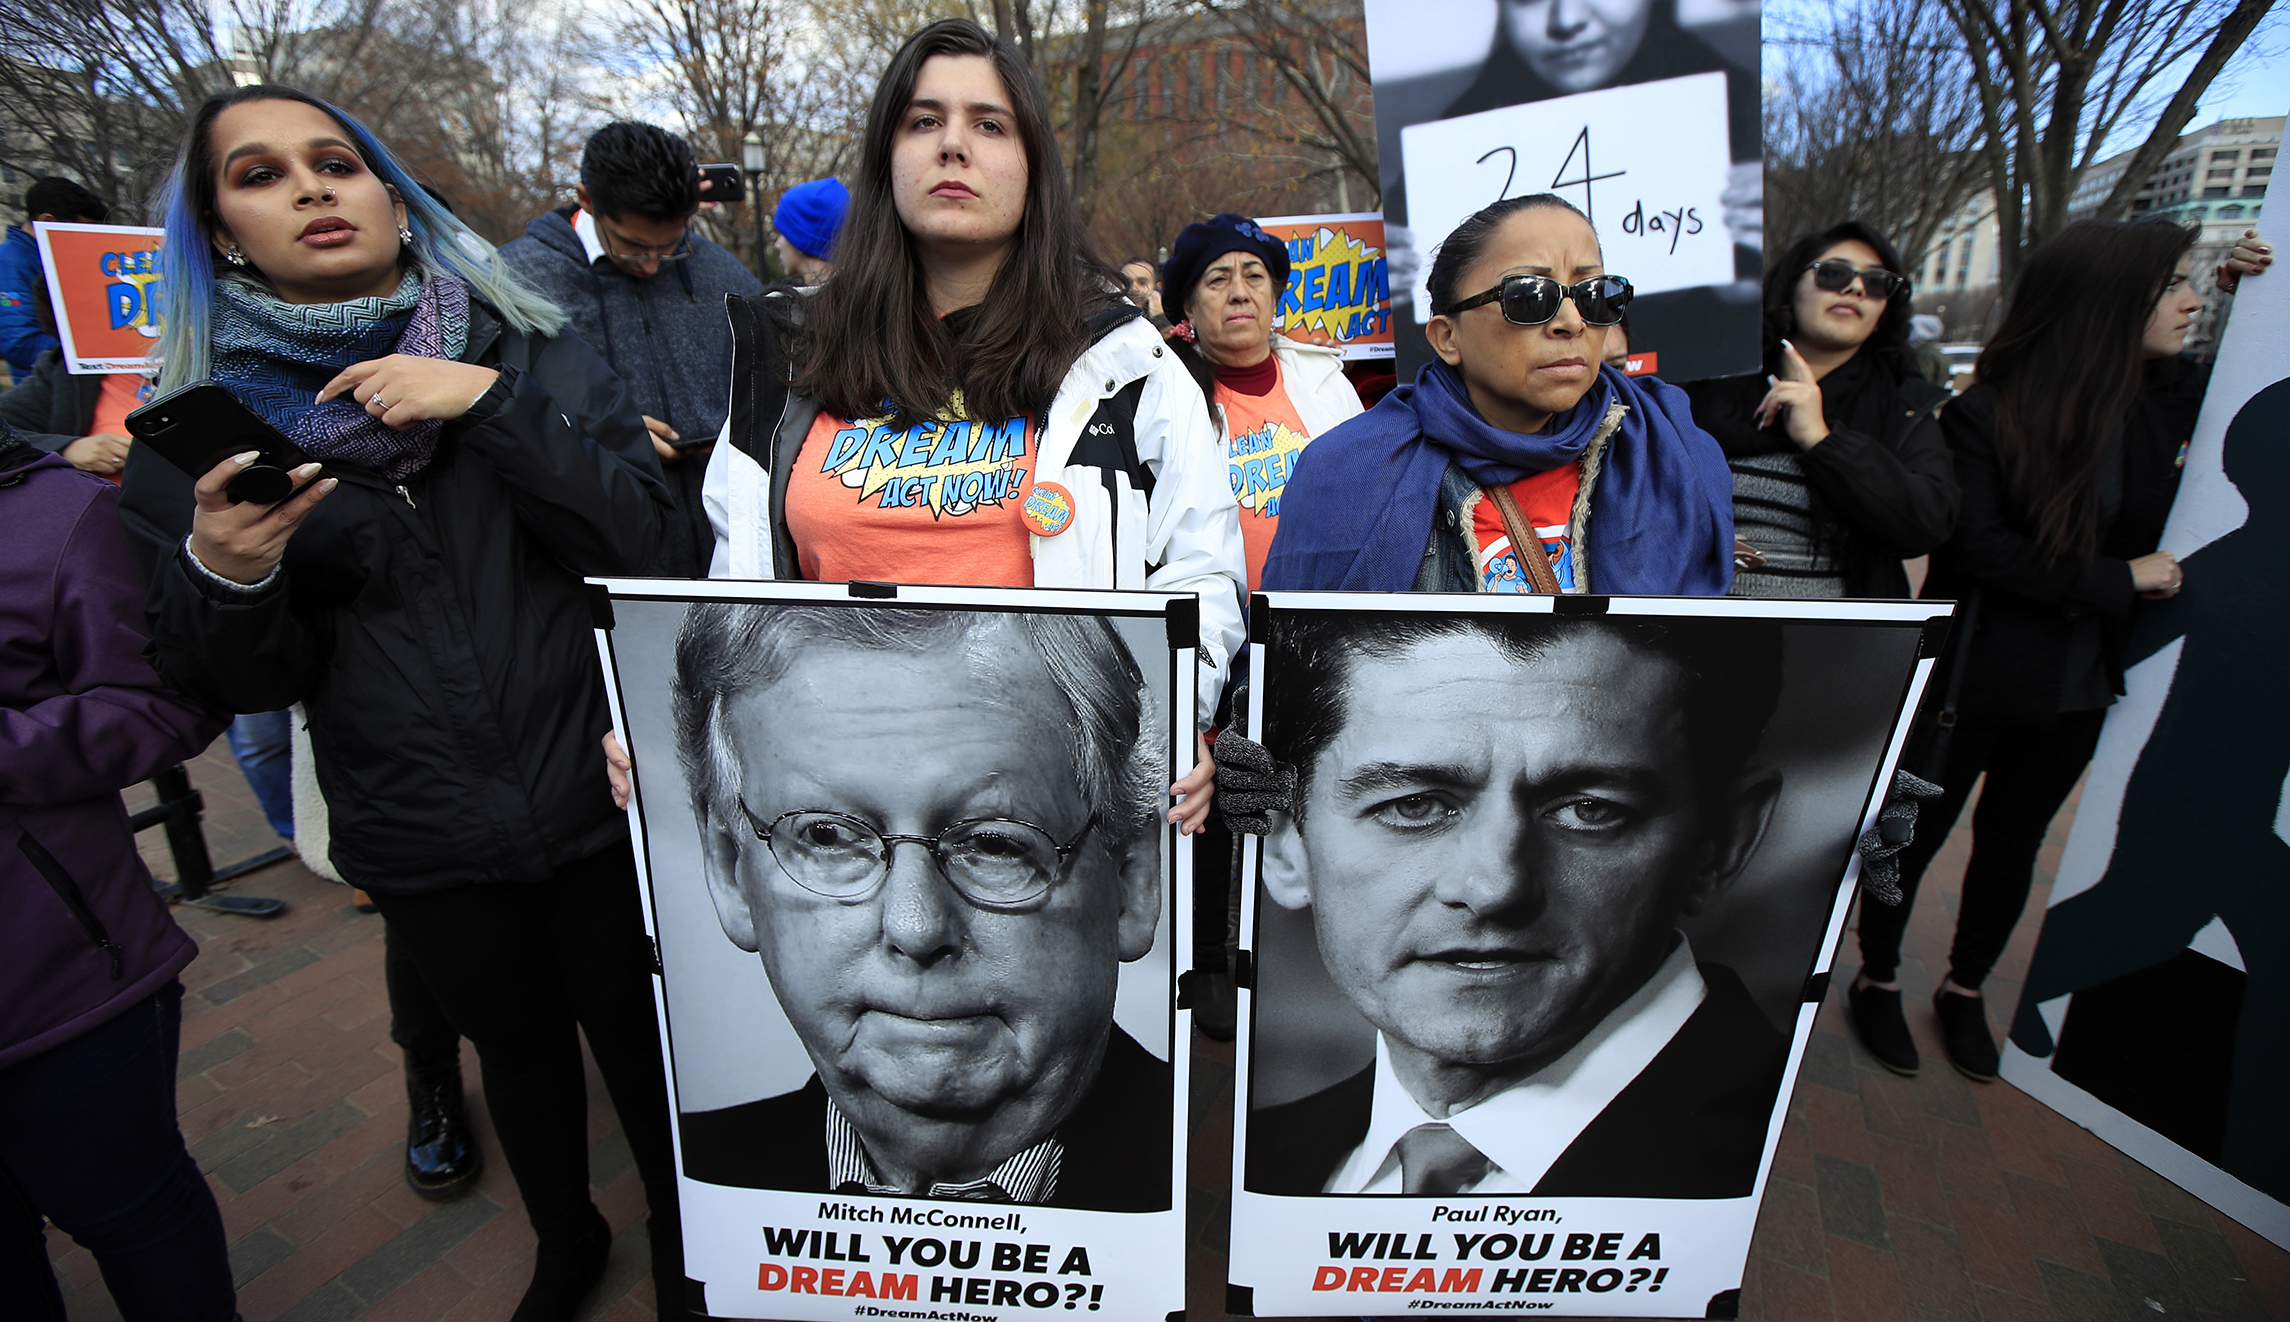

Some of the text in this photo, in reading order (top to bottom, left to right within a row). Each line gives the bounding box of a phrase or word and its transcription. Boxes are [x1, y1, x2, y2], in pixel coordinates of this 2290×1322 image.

[1622, 198, 1703, 255] days
[1287, 235, 1316, 264] AN
[1276, 258, 1391, 318] REAM
[1345, 307, 1392, 340] ACT
[820, 416, 1027, 473] DREAM
[1229, 428, 1274, 459] LEAN
[878, 468, 1028, 509] ACT NOW!
[1031, 485, 1058, 502] CLEAN
[1022, 495, 1071, 525] DREAM
[1047, 521, 1064, 533] ACT
[818, 1202, 1027, 1235] Mitch McConnell,
[1431, 1205, 1563, 1226] Paul Ryan,
[762, 1226, 1092, 1277] WILL YOU BE A
[1328, 1232, 1661, 1262] WILL YOU BE A
[757, 1263, 1104, 1312] DREAM HERO?!
[1311, 1266, 1670, 1294] DREAM HERO?!
[854, 1305, 998, 1322] #DreamActNow
[1408, 1299, 1554, 1310] #DreamActNow
